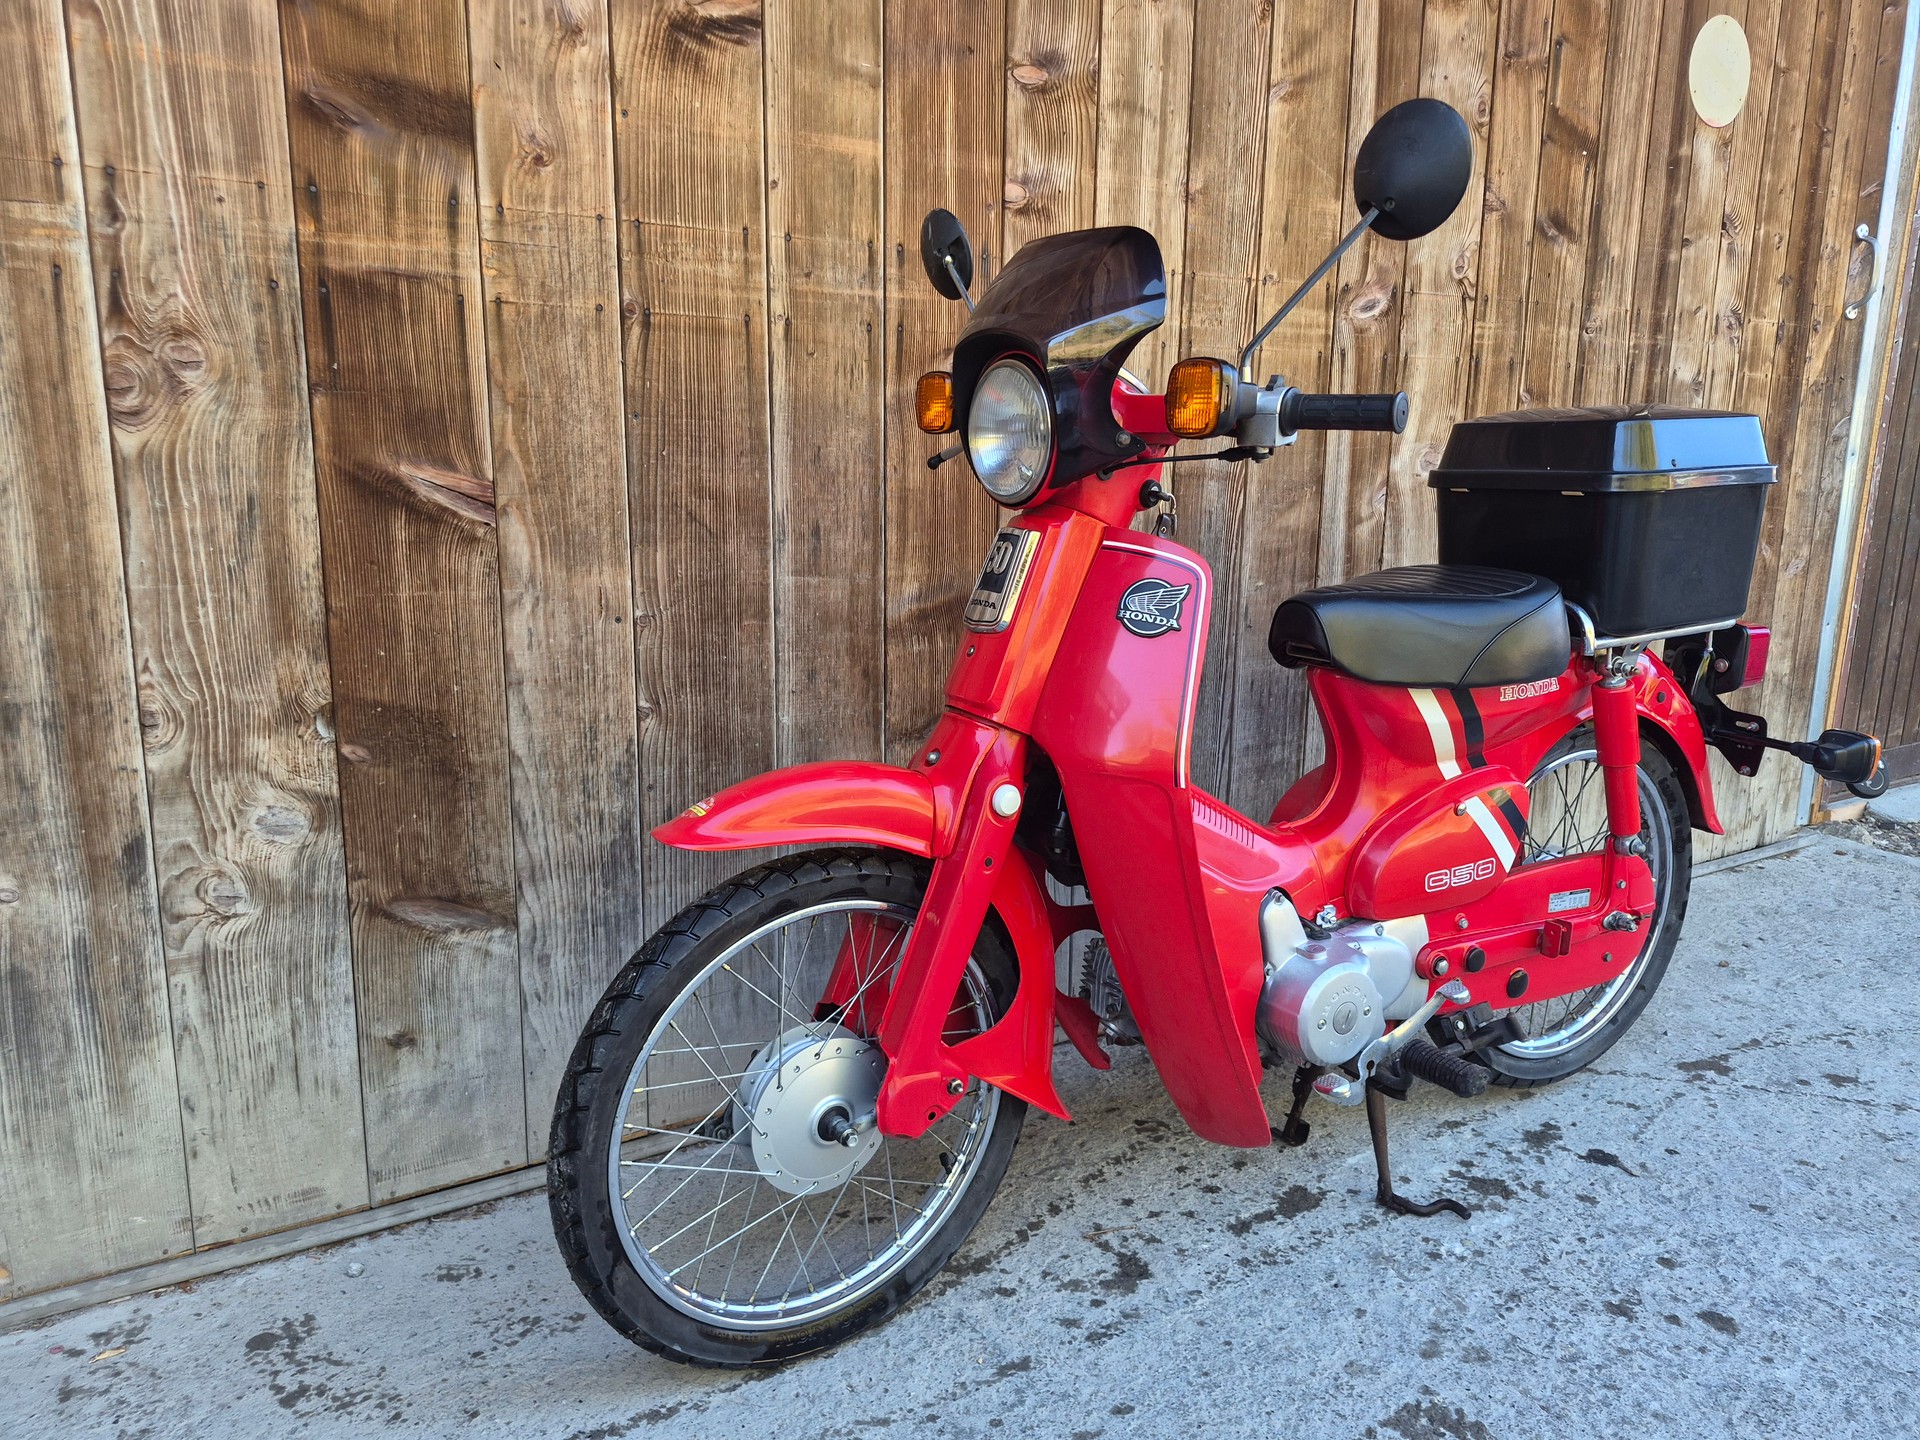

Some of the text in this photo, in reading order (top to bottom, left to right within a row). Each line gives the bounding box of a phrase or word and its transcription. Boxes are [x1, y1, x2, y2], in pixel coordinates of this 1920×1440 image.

[1118, 609, 1180, 629] HONDA
[1500, 677, 1560, 702] HONDA
[1425, 857, 1496, 893] C50
